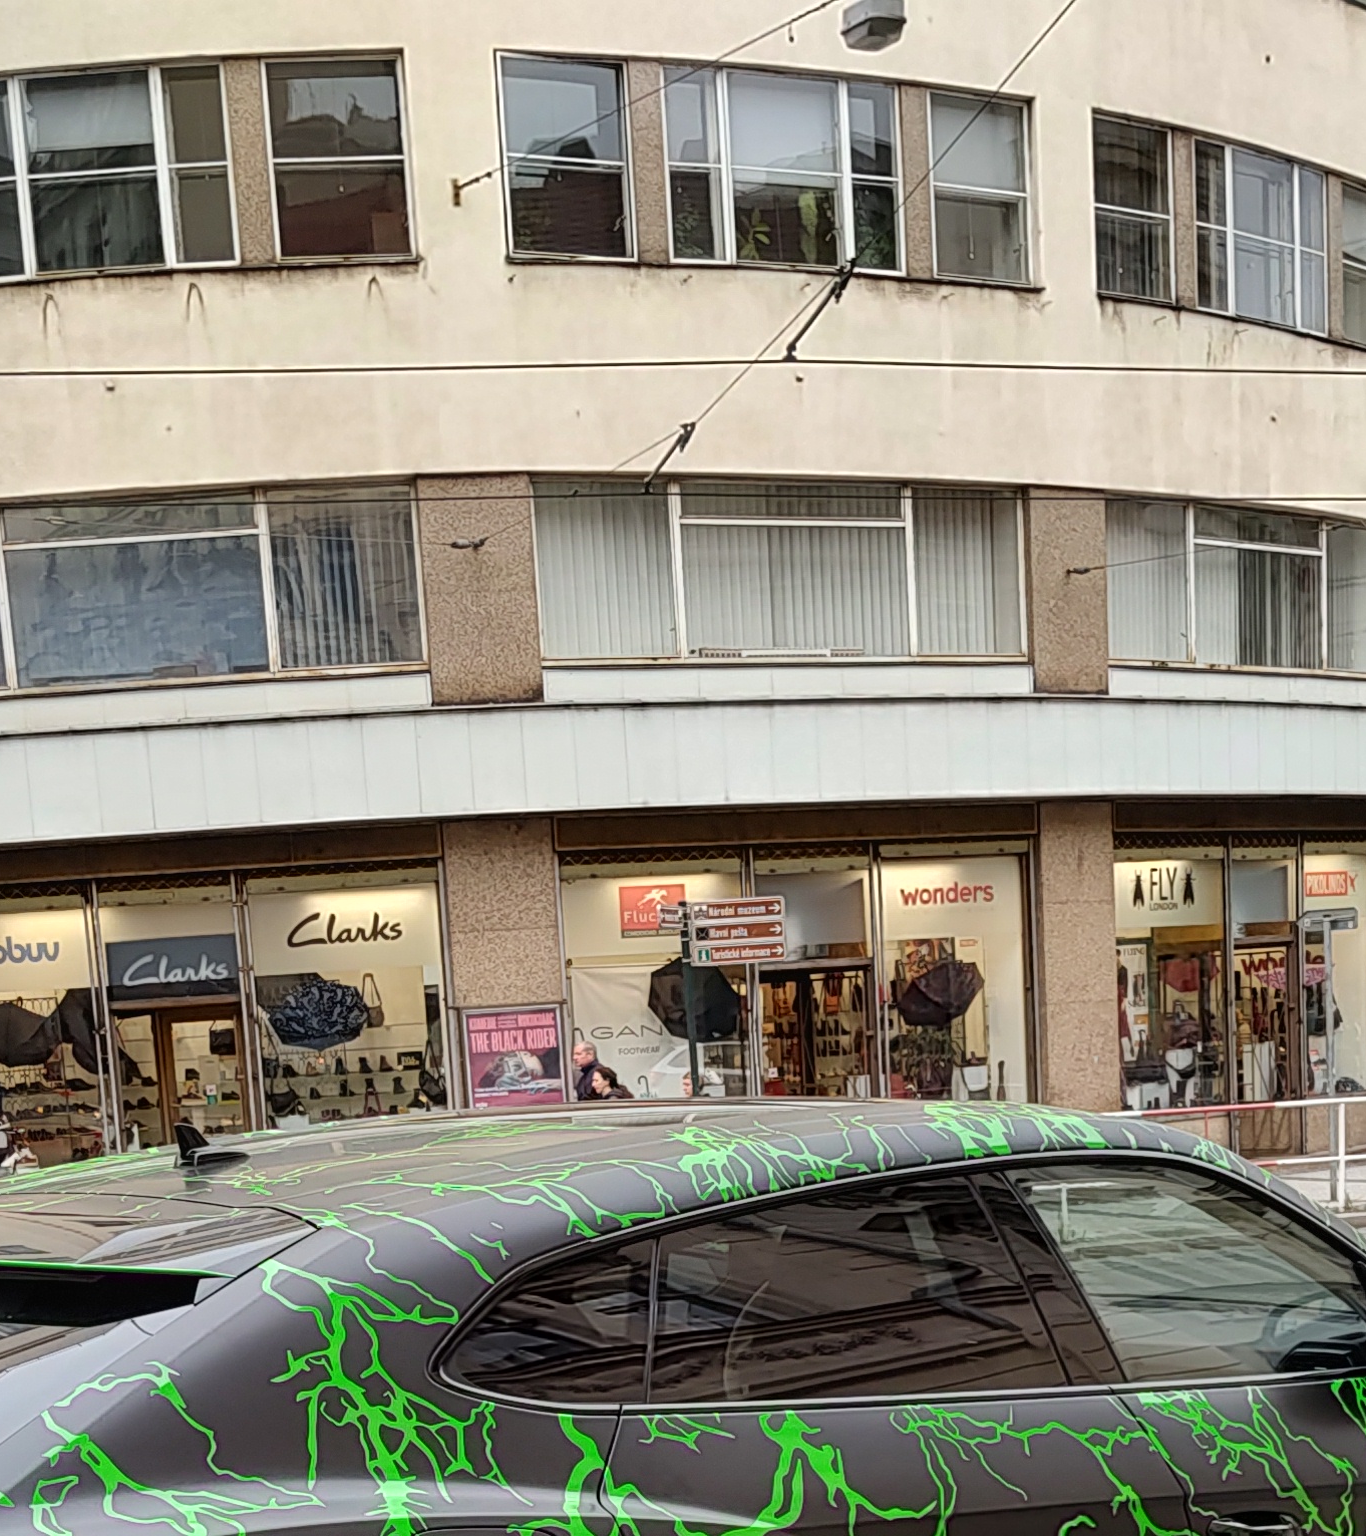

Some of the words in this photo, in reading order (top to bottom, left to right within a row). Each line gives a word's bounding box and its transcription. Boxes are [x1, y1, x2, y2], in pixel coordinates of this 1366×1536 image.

[900, 881, 995, 906] wonders
[1149, 867, 1178, 901] FLY
[1307, 874, 1347, 895] PIKOLINOS
[1149, 902, 1179, 912] LONDON
[287, 911, 403, 948] Clarks
[121, 953, 230, 987] Clarks
[470, 1032, 491, 1054] THE
[491, 1030, 526, 1053] BLACK
[525, 1027, 558, 1050] RIDER
[590, 1024, 663, 1040] GAN
[618, 1045, 661, 1056] FOOTWEAR
